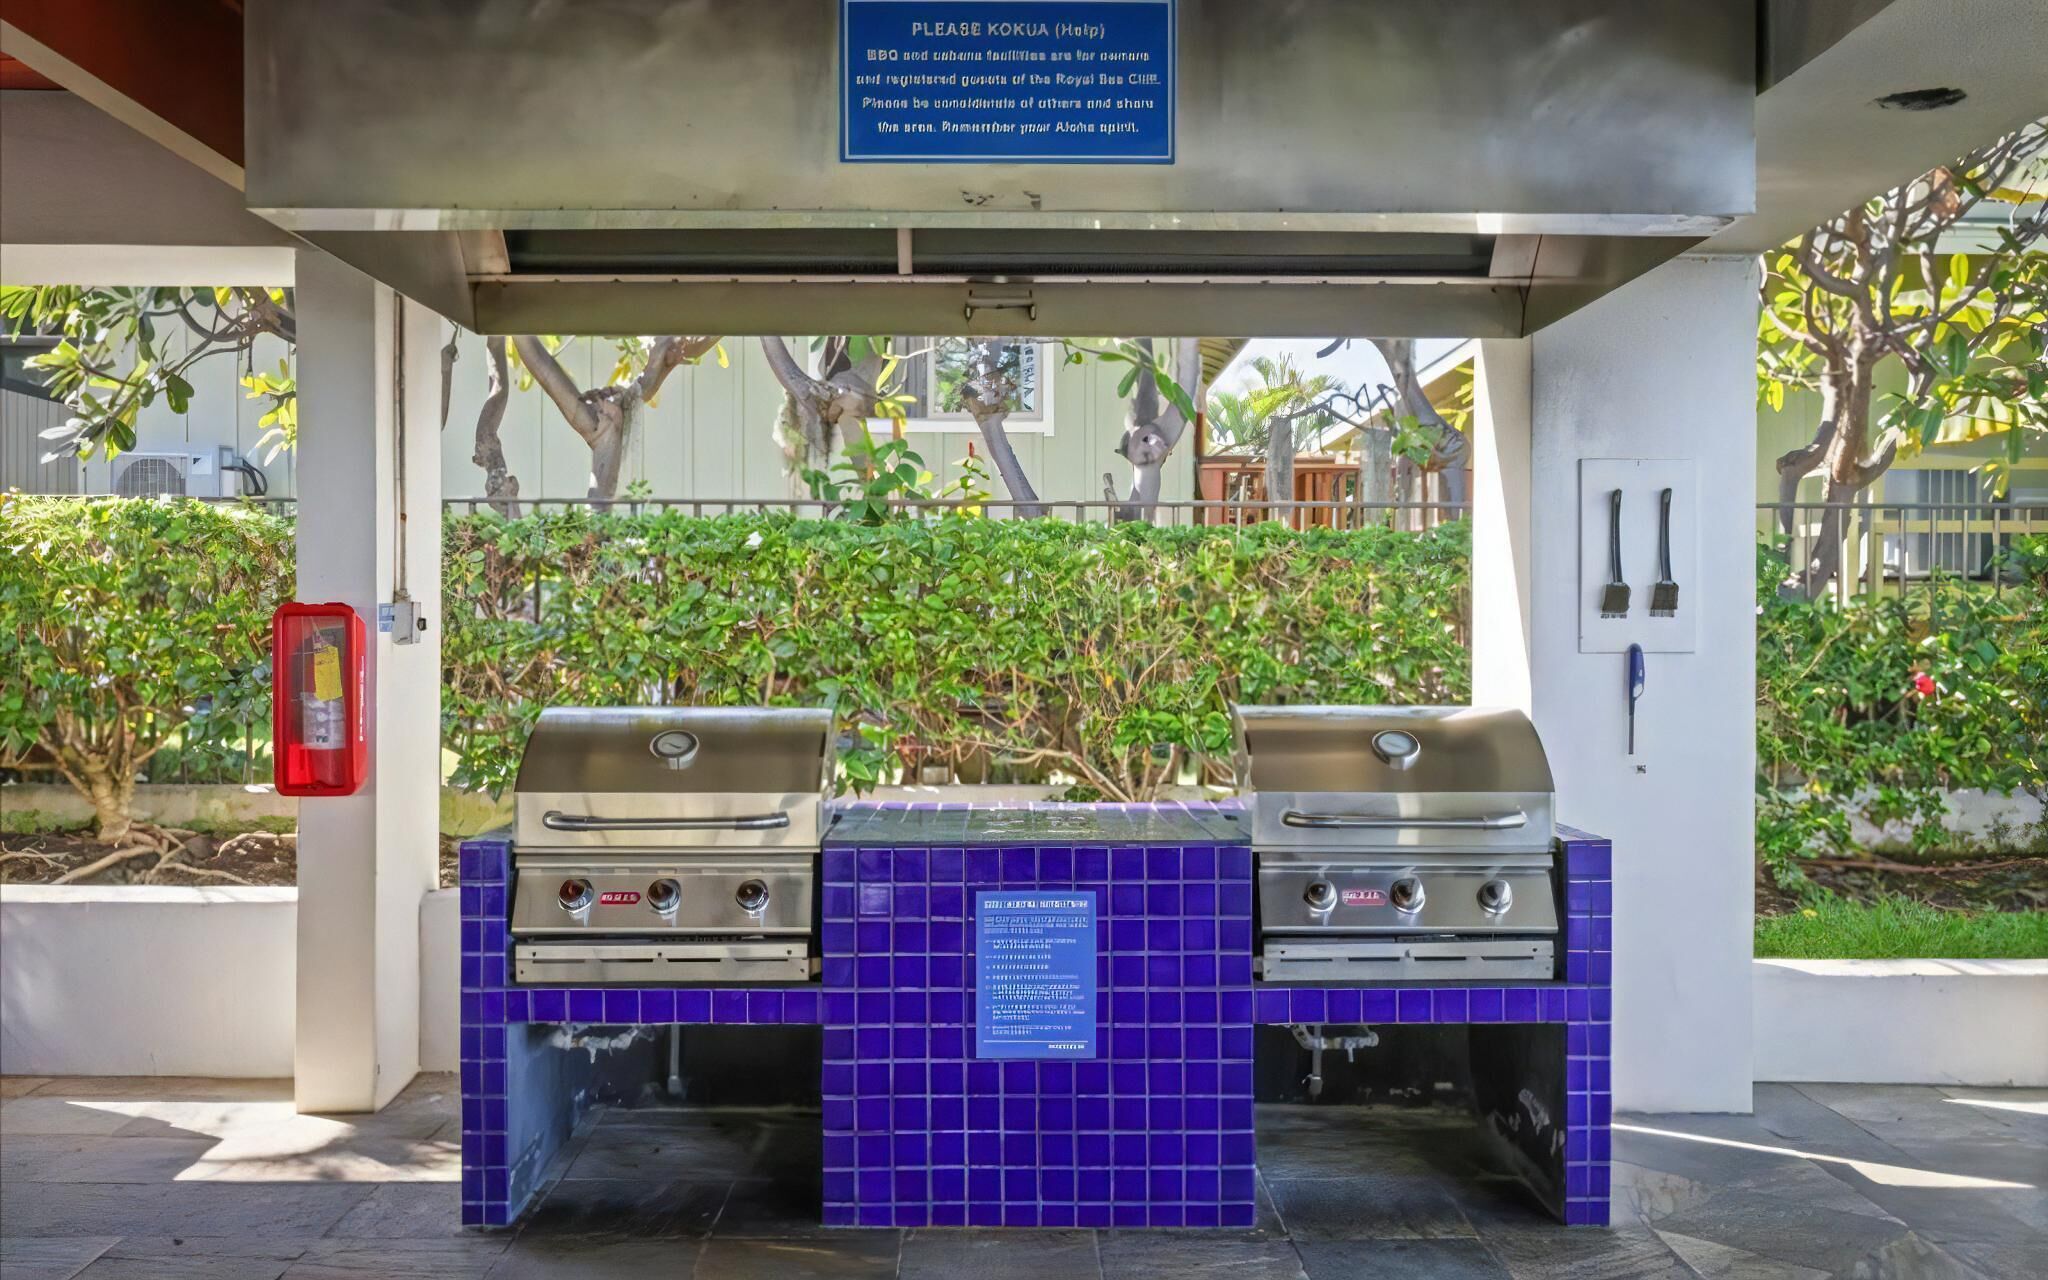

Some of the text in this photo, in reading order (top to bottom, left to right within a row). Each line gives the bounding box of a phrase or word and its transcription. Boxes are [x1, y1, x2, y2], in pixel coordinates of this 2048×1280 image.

[912, 22, 981, 37] PLEASE
[987, 22, 1049, 37] KOKUA
[1029, 74, 1051, 85] the
[1055, 72, 1095, 88] Royal
[1020, 96, 1034, 109] of
[1086, 98, 1112, 109] and
[1055, 121, 1095, 133] Aloha
